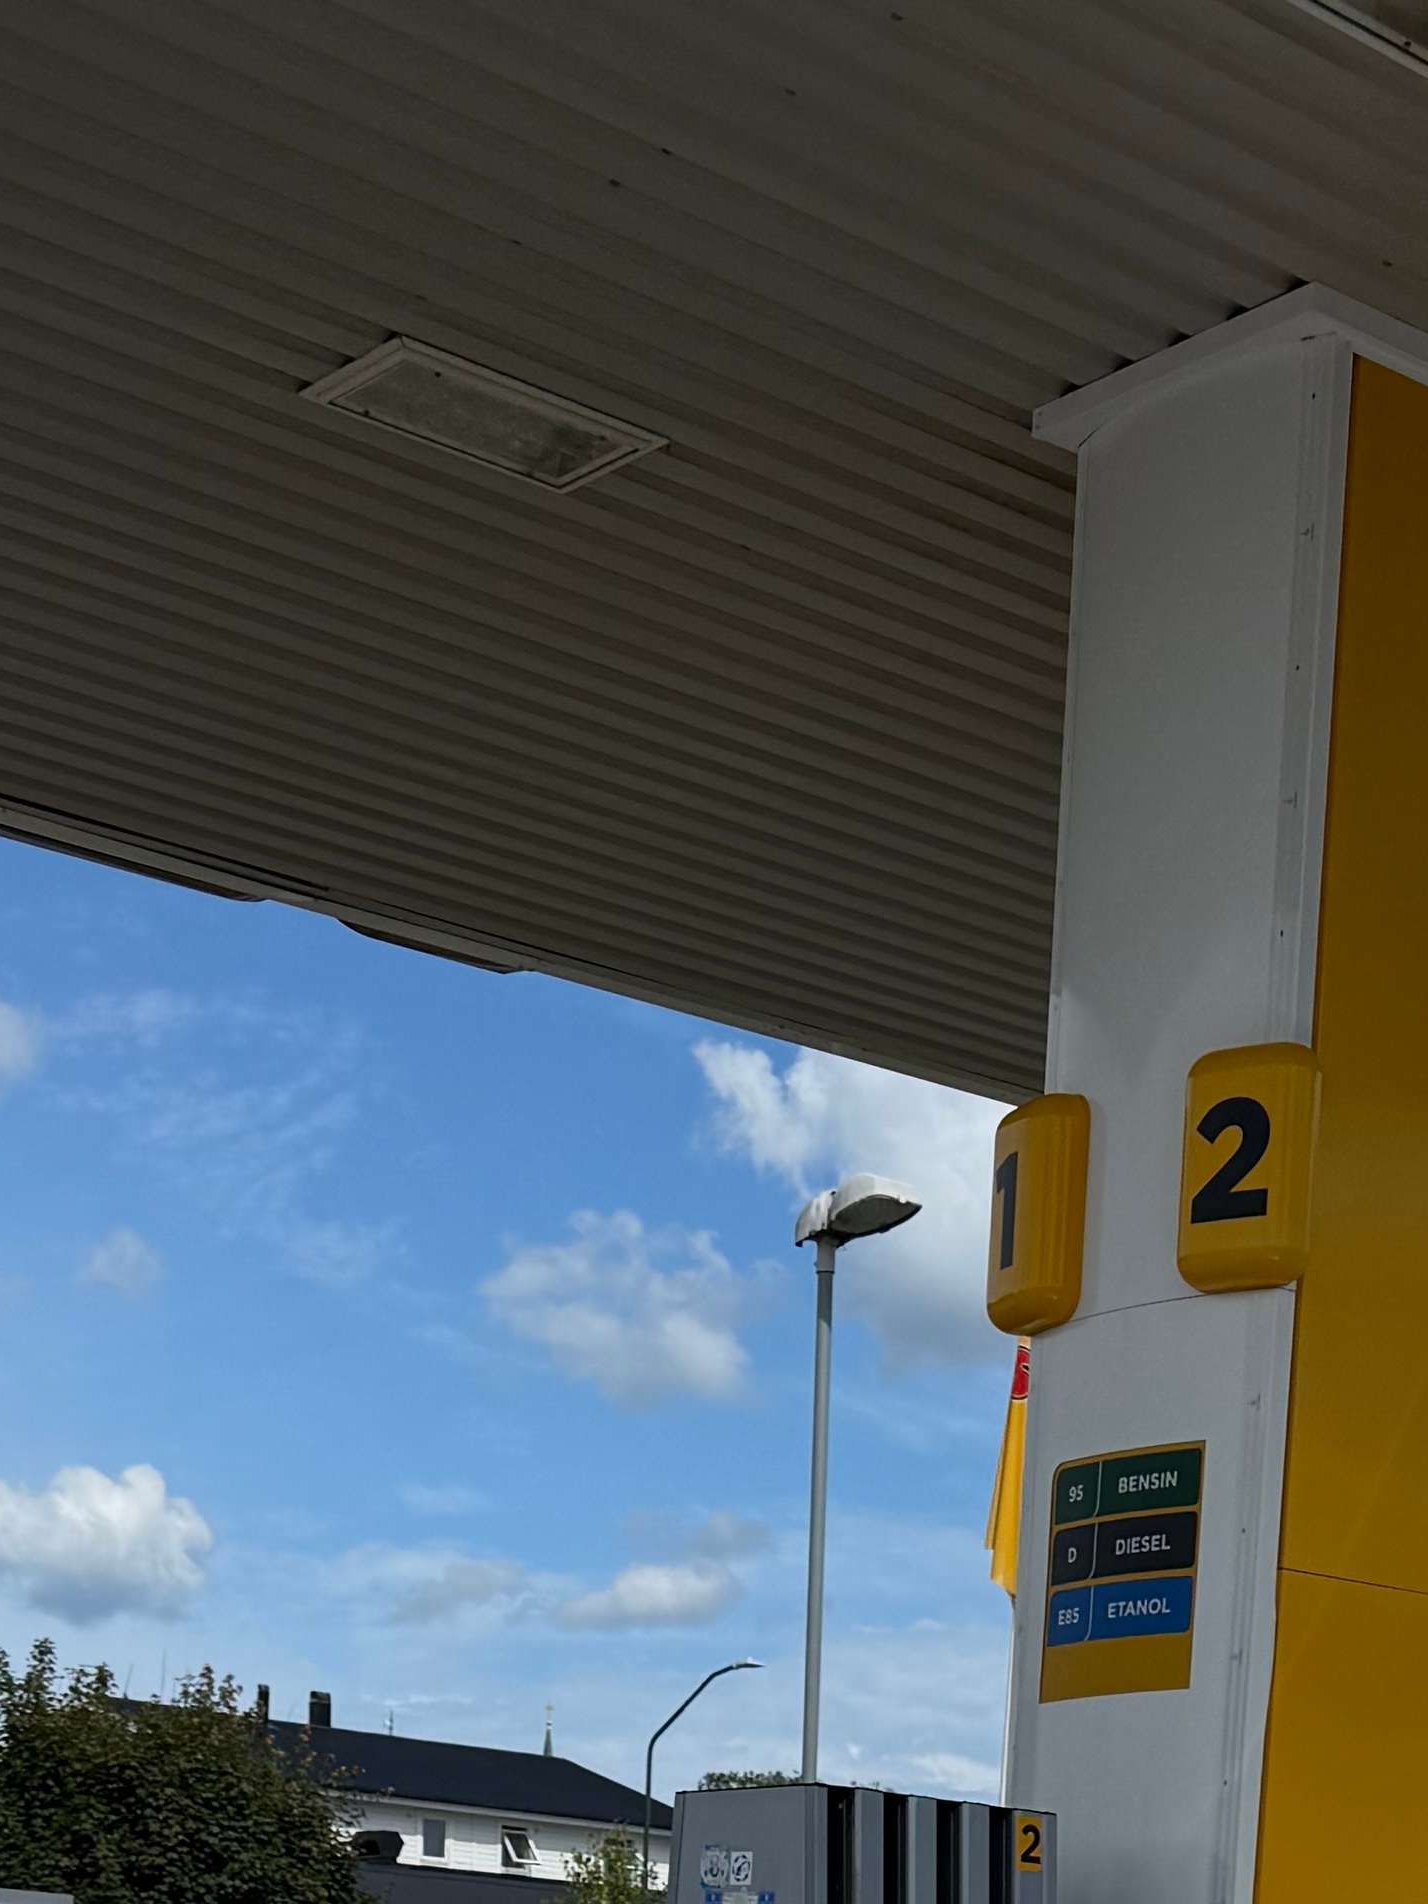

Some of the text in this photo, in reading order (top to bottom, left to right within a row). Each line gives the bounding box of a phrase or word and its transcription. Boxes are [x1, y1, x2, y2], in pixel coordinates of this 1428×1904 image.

[1190, 1096, 1271, 1225] 2
[996, 1151, 1019, 1271] 1
[1069, 1471, 1178, 1502] 95 BENSIN
[1067, 1534, 1171, 1563] D DIESEL
[1058, 1598, 1171, 1626] E85 ETANOL
[1021, 1824, 1041, 1865] 2
